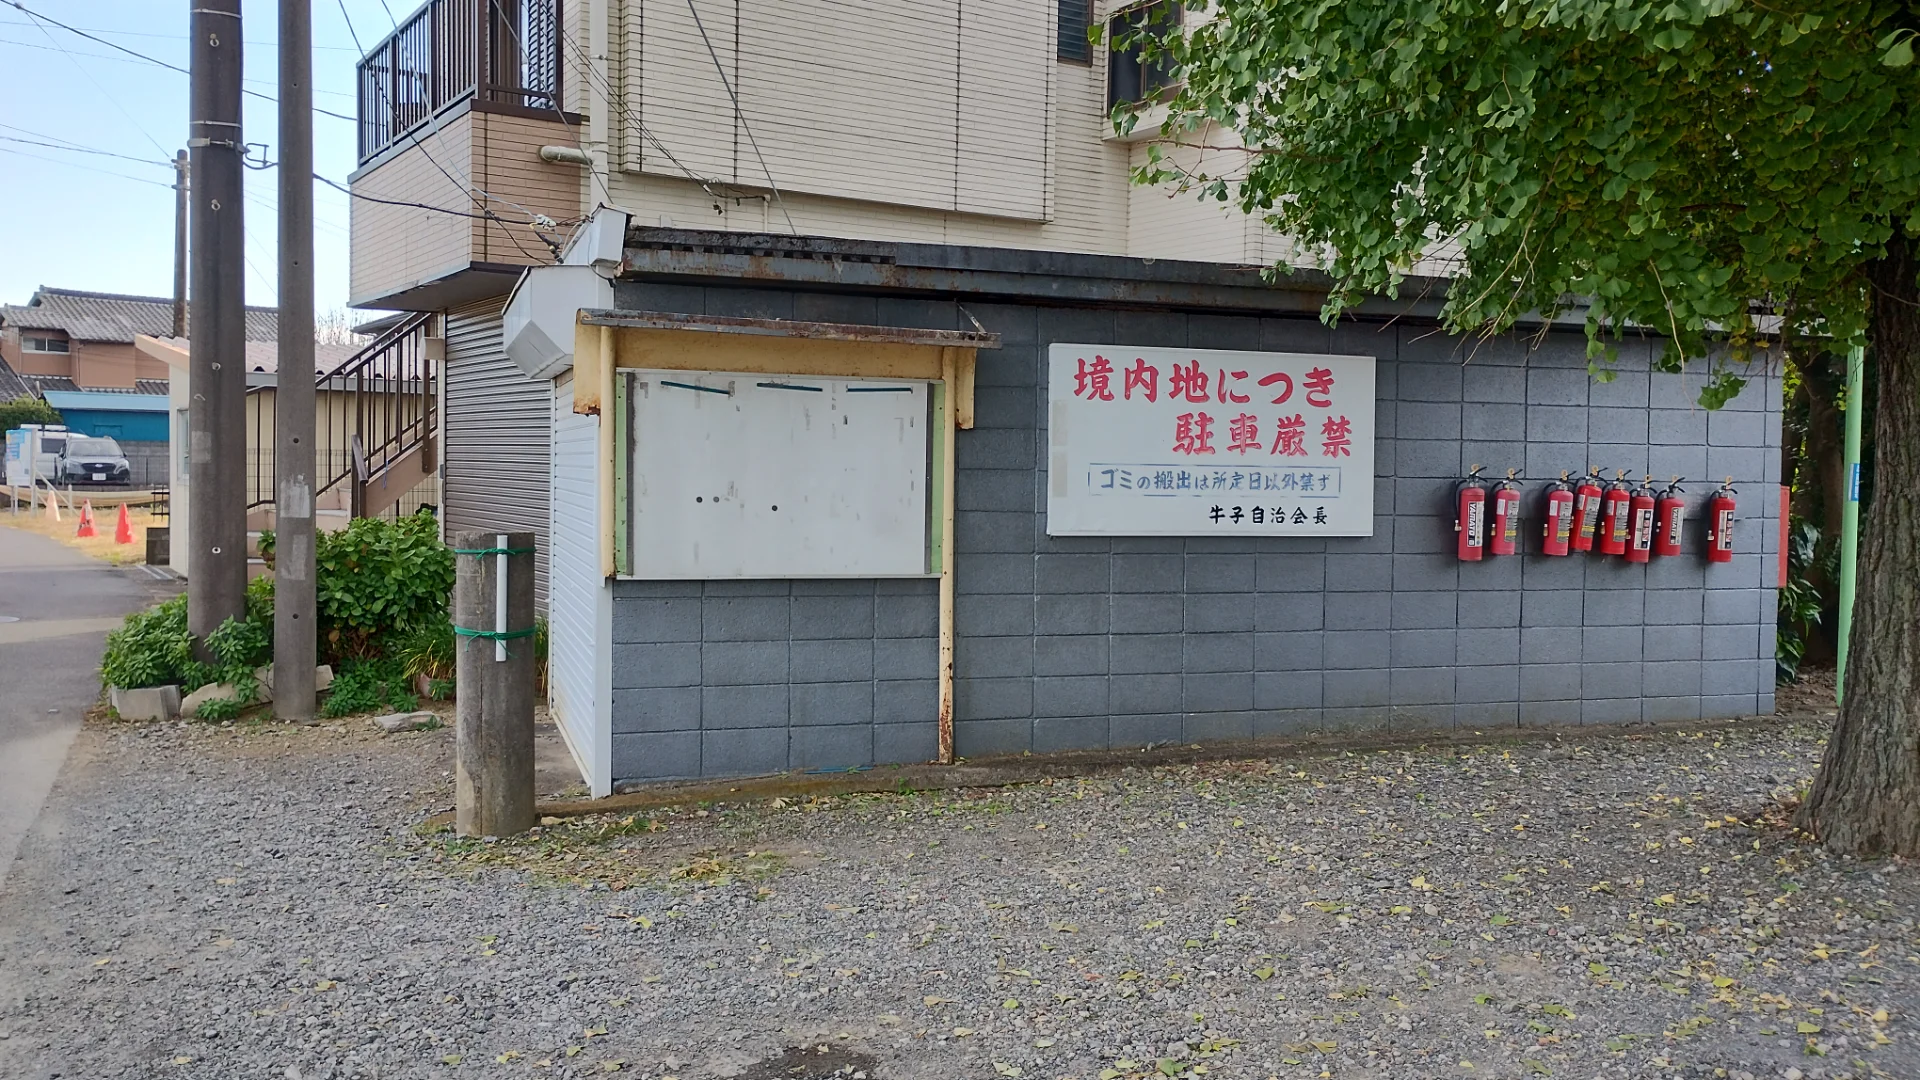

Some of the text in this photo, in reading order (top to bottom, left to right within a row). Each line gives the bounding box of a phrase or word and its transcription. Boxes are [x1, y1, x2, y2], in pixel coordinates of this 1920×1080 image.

[1074, 355, 1335, 407] 境内地につき
[1173, 412, 1351, 458] 駐車厳禁
[1209, 504, 1327, 525] 牛子自治会長
[1468, 502, 1477, 536] YAMATO
